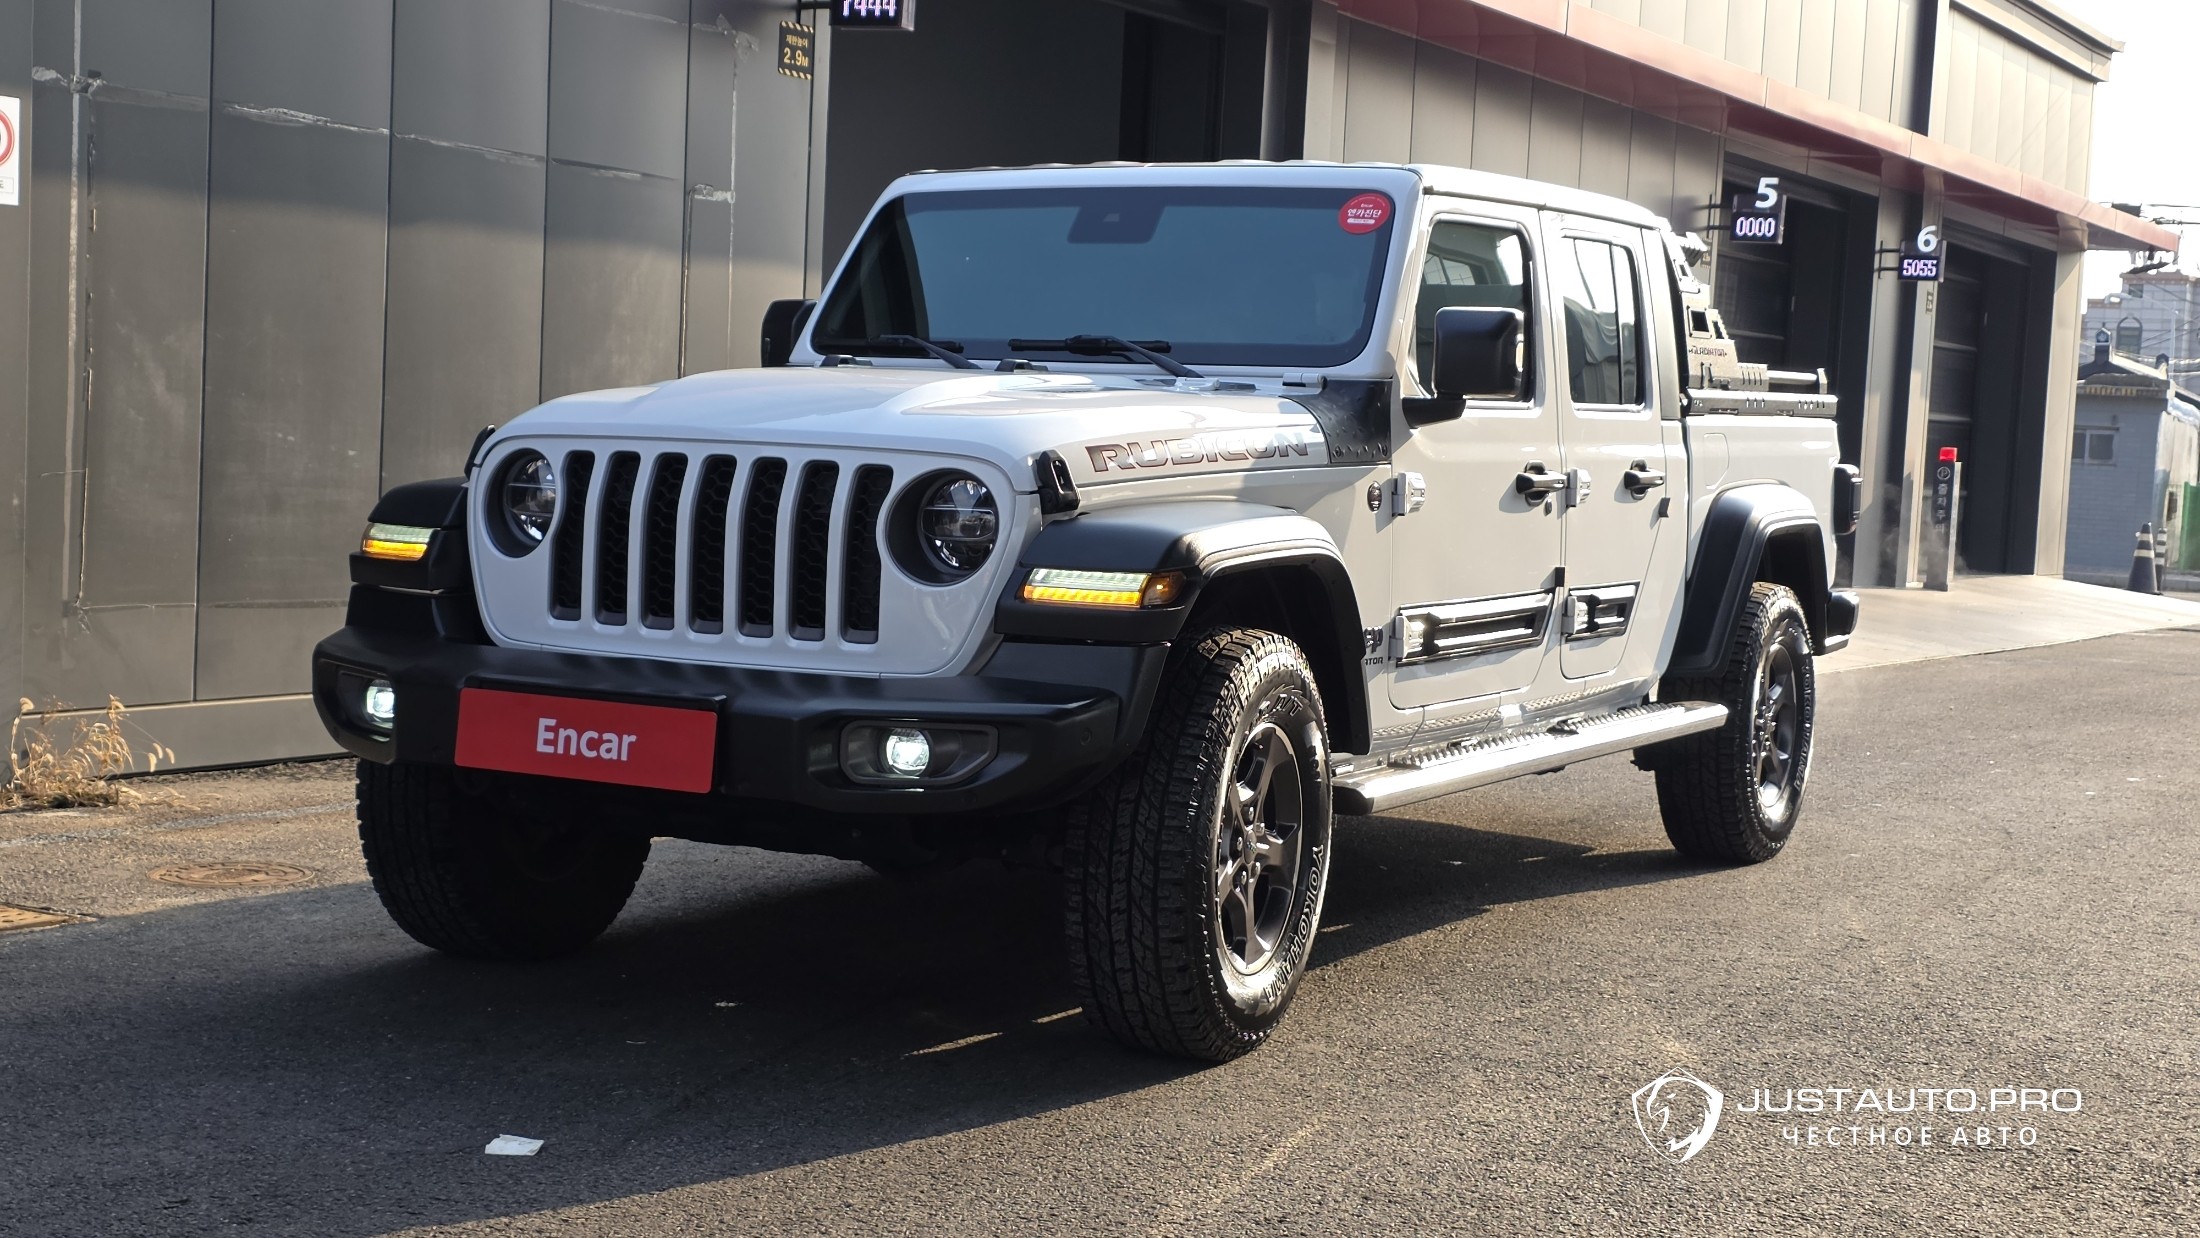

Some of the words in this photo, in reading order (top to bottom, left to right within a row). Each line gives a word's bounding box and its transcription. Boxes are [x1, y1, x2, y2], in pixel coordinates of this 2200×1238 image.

[783, 47, 809, 67] 2.9M
[1754, 177, 1780, 209] 5
[1347, 208, 1382, 218] 엔카진단
[1735, 216, 1776, 238] 0000
[1917, 225, 1938, 253] 6
[1902, 259, 1938, 277] 5055
[1084, 430, 1309, 473] RUBICON
[536, 717, 637, 762] Encar
[1263, 844, 1324, 1003] YOKOHAMA
